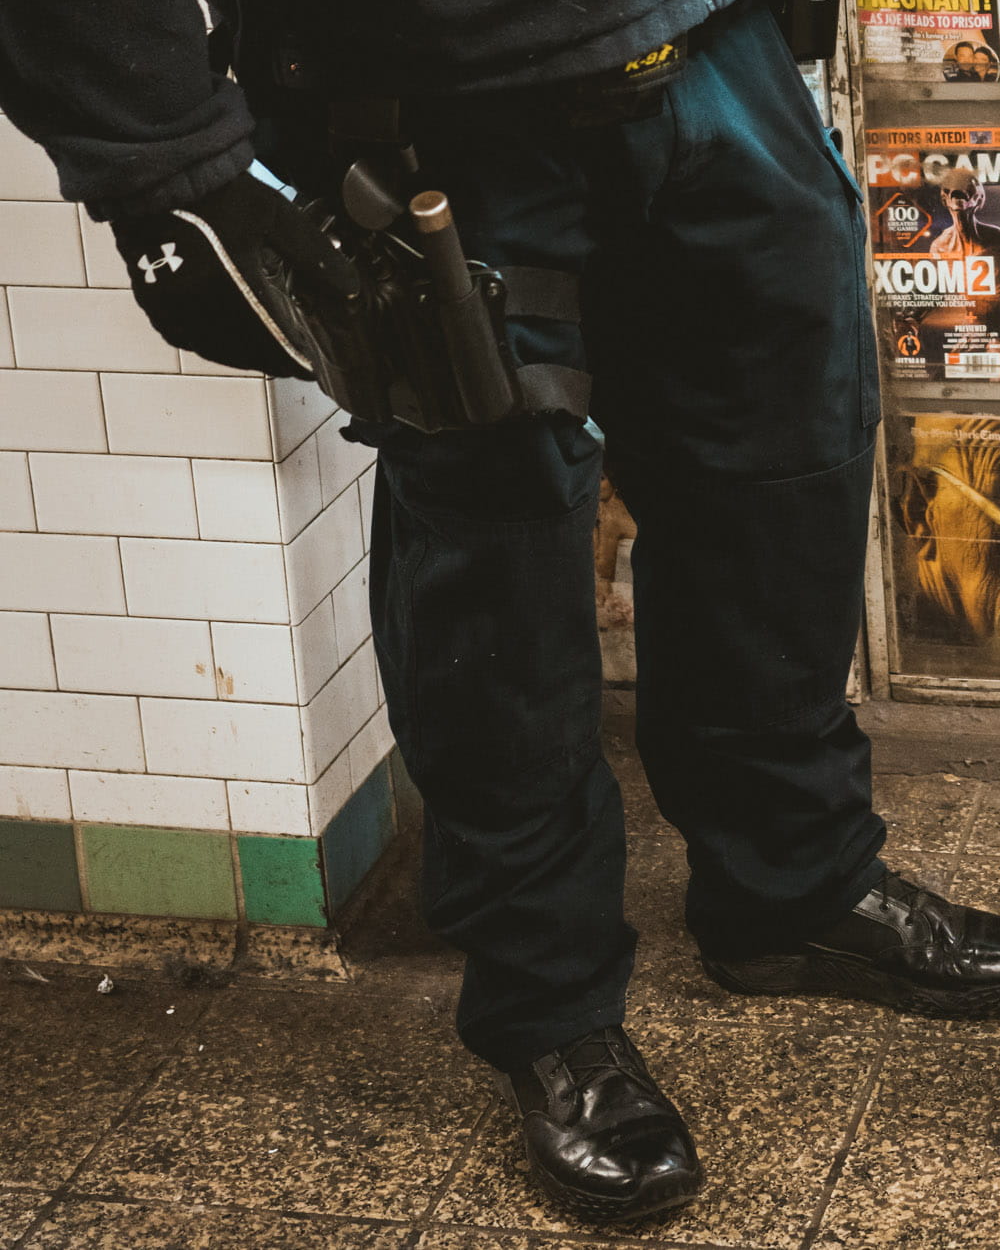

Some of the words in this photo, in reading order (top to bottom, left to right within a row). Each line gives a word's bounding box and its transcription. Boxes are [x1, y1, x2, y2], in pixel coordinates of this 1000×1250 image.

[904, 14, 935, 26] HEADS
[937, 14, 950, 27] TO
[952, 15, 990, 28] PRISON
[867, 154, 919, 183] PC
[887, 206, 920, 221] 100
[873, 260, 966, 294] XCOM
[970, 260, 991, 292] 2
